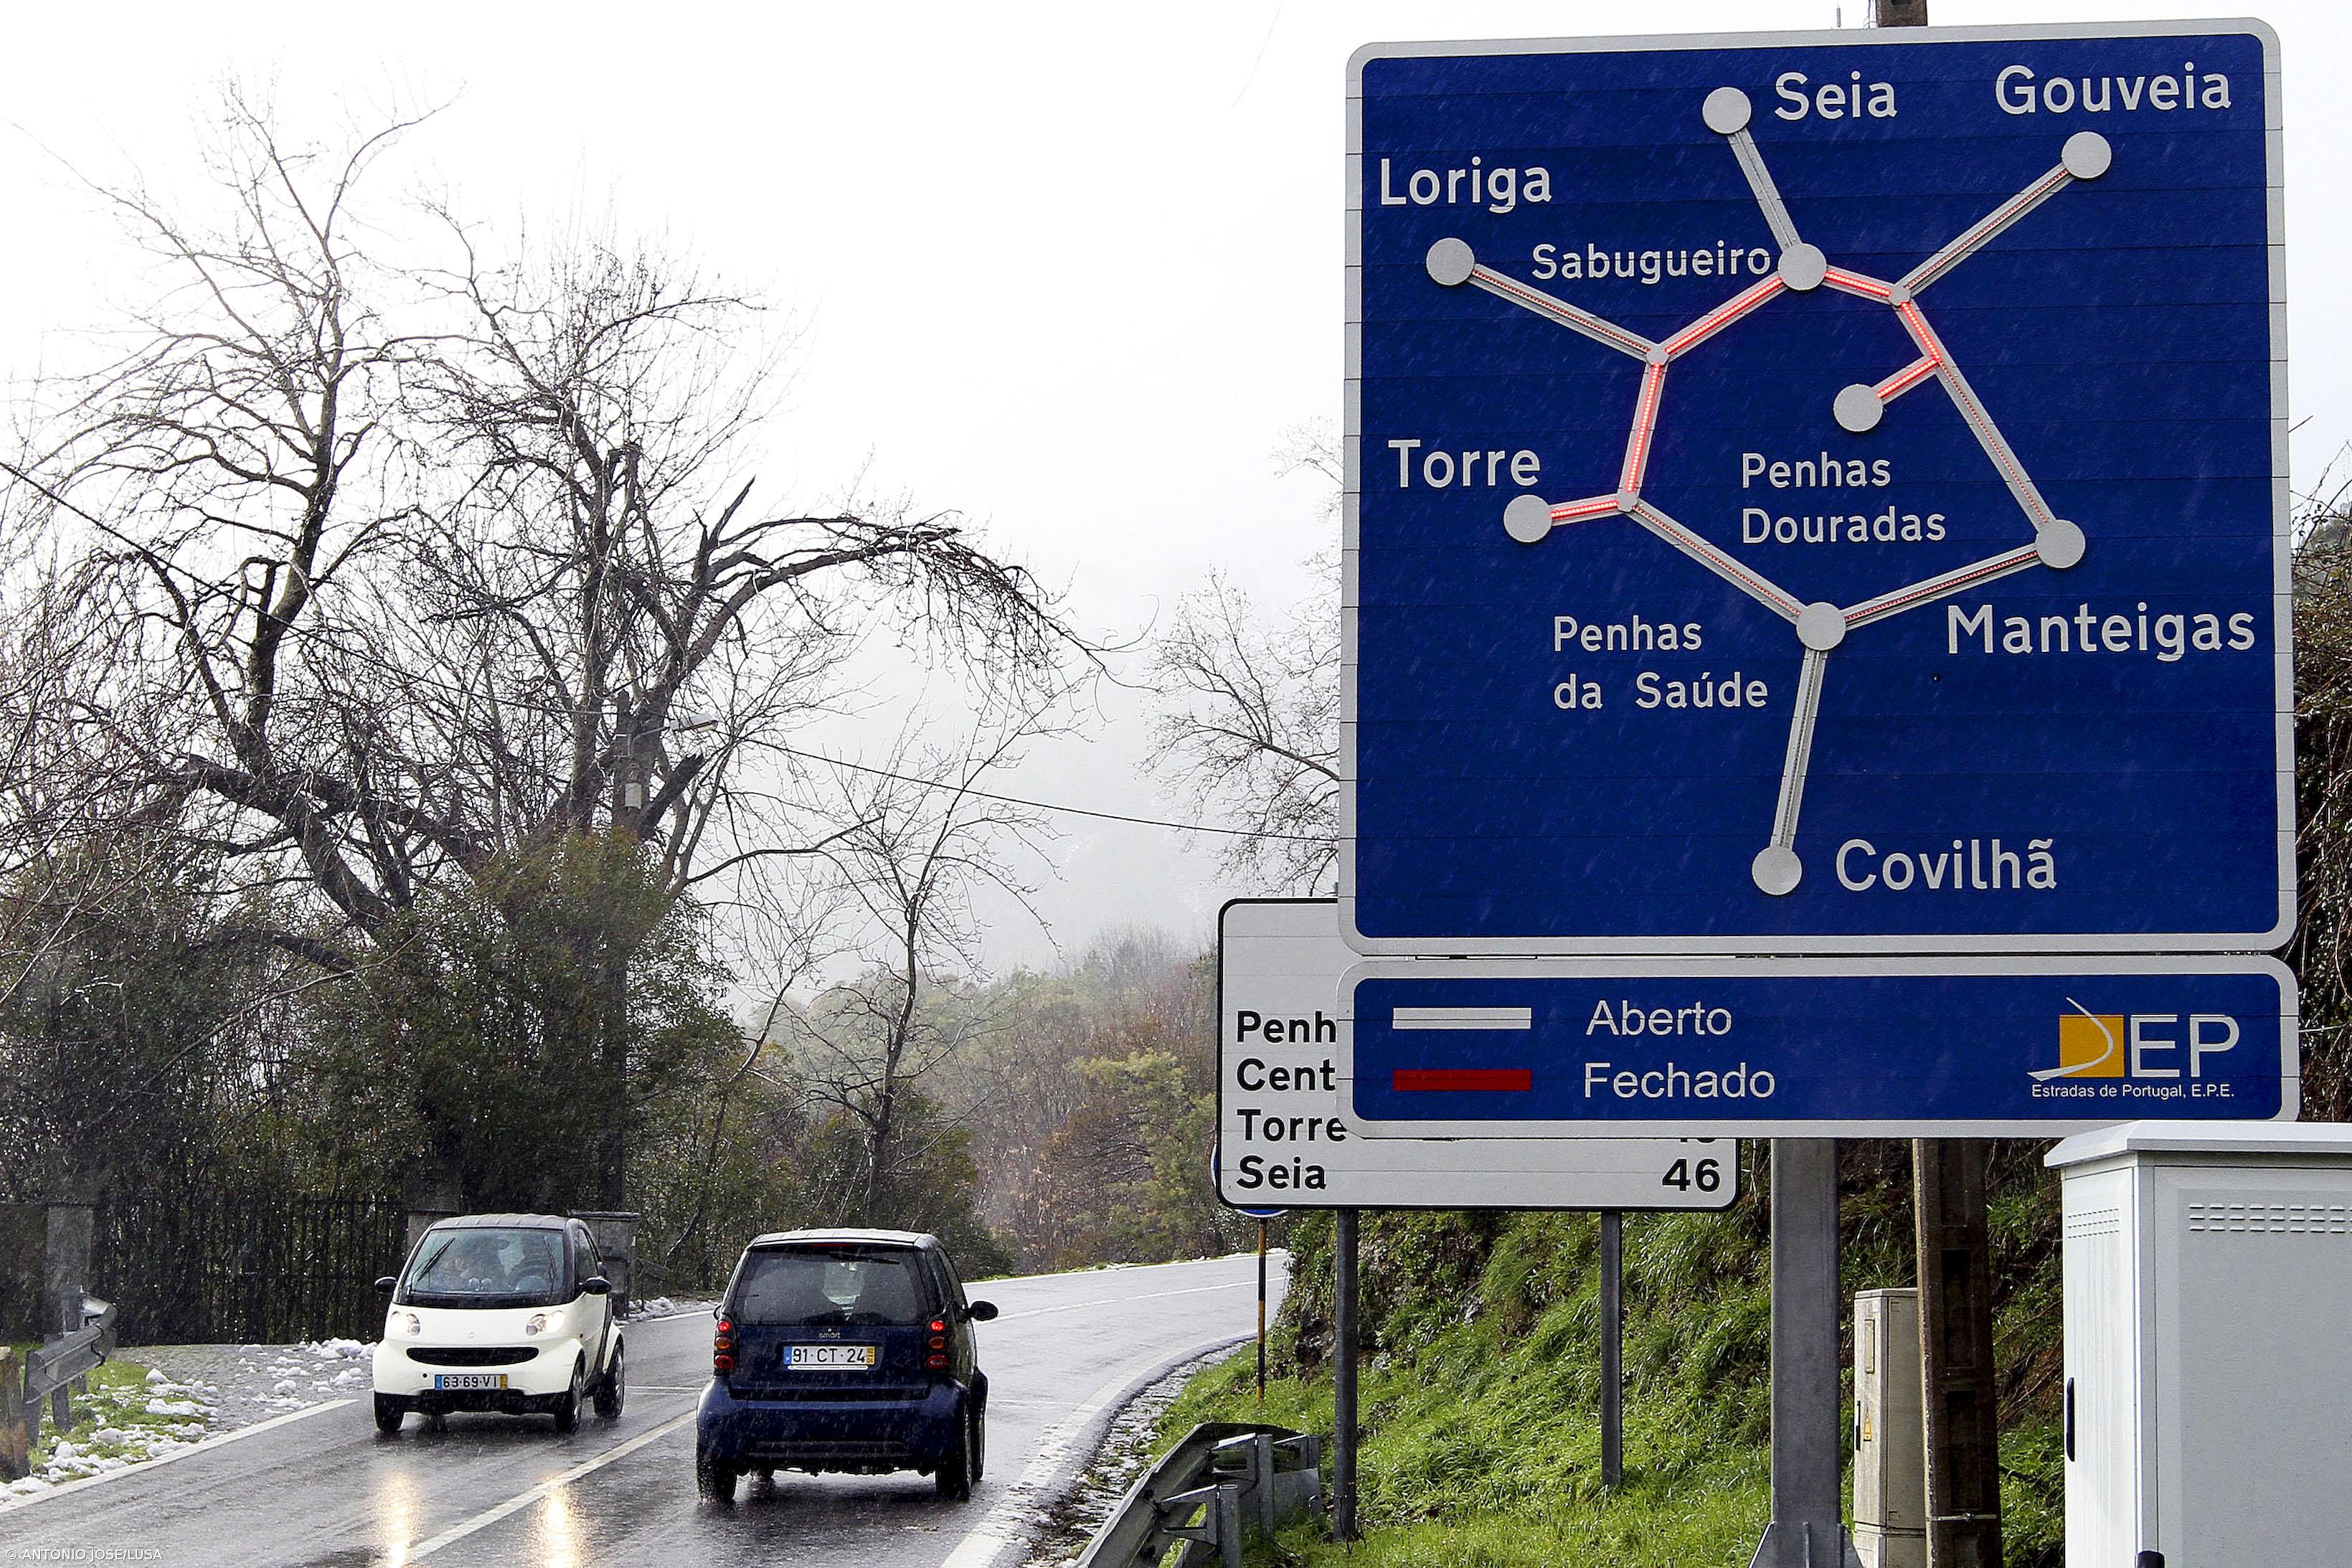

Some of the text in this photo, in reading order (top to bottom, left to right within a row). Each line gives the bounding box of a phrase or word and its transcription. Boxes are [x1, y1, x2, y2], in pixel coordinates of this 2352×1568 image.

[1775, 70, 1898, 121] Seia
[1995, 61, 2231, 115] Gouveia
[1381, 156, 1552, 214] Loriga
[1531, 240, 1772, 284] Sabugueiro
[1388, 439, 1541, 488] Torre
[1742, 451, 1891, 488] Penhas
[1742, 505, 1946, 544] Douradas
[1554, 615, 1702, 651] Penhas
[1947, 602, 2255, 662] Manteigas
[1554, 671, 1768, 709] da Saúde
[1836, 839, 2057, 892] Covilhã
[1585, 1000, 1732, 1036] Aberto
[2130, 1014, 2240, 1077] EP
[1584, 1062, 1775, 1098] Fechado
[2031, 1084, 2235, 1100] Estradas de Portugal, E.P.E.
[1237, 1109, 1348, 1142] Torre
[1236, 1155, 1720, 1192] Seia 46
